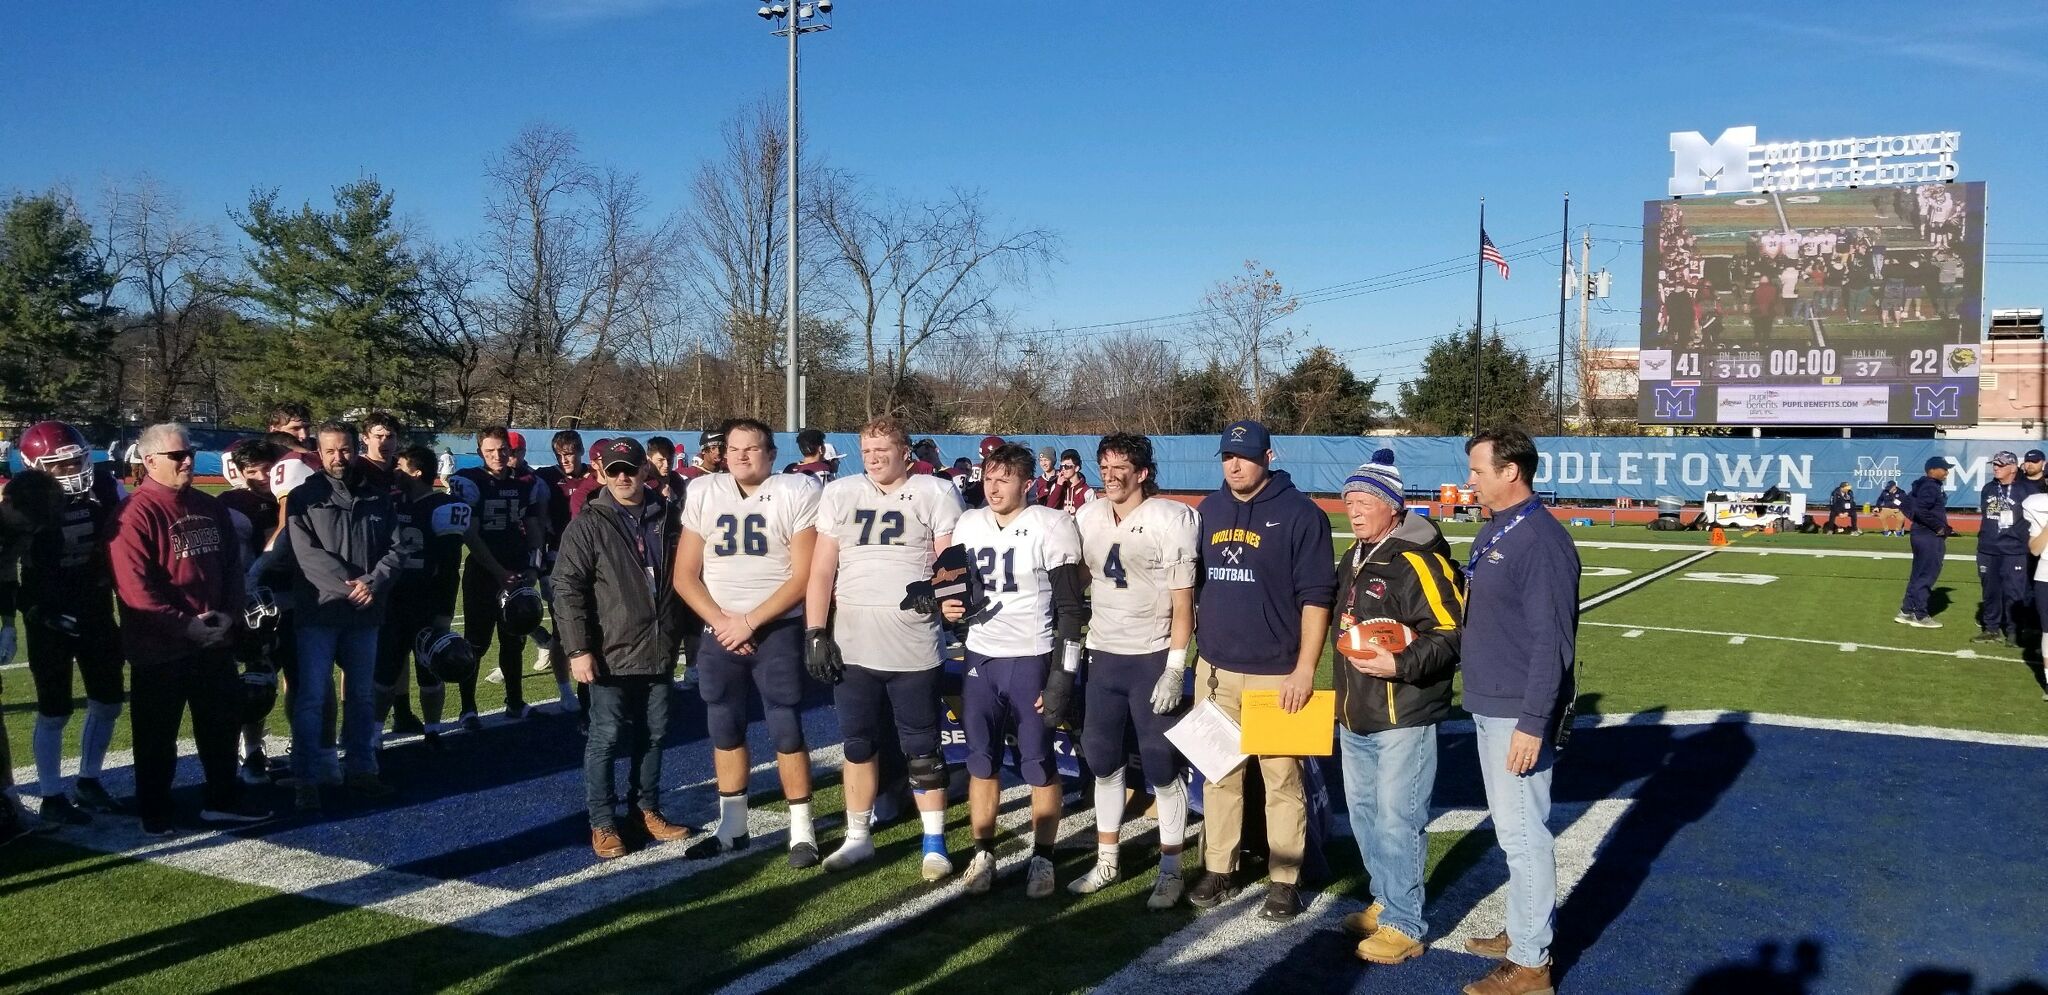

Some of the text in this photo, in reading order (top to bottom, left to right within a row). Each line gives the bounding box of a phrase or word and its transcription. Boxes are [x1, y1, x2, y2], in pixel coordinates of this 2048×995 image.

[1669, 126, 1756, 195] M
[1764, 132, 1960, 165] MIDDLETOWN
[1875, 161, 1960, 183] FIELD
[1675, 353, 1701, 376] 41
[1718, 364, 1761, 378] 3 10
[1770, 349, 1836, 376] 00:00
[1855, 361, 1882, 377] 37
[1909, 349, 1938, 374] 22
[1655, 388, 1695, 417] M
[1914, 386, 1959, 417] M
[275, 463, 285, 486] 9
[1532, 452, 1813, 488] DDLETOWN
[1854, 469, 1902, 477] MIDDIES
[450, 506, 470, 526] 62
[854, 509, 905, 546] 72
[170, 527, 220, 553] RAIDERS
[714, 513, 769, 557] 36
[976, 546, 1019, 593] 21
[1103, 543, 1128, 589] 4
[1208, 566, 1256, 583] FOOTBALL
